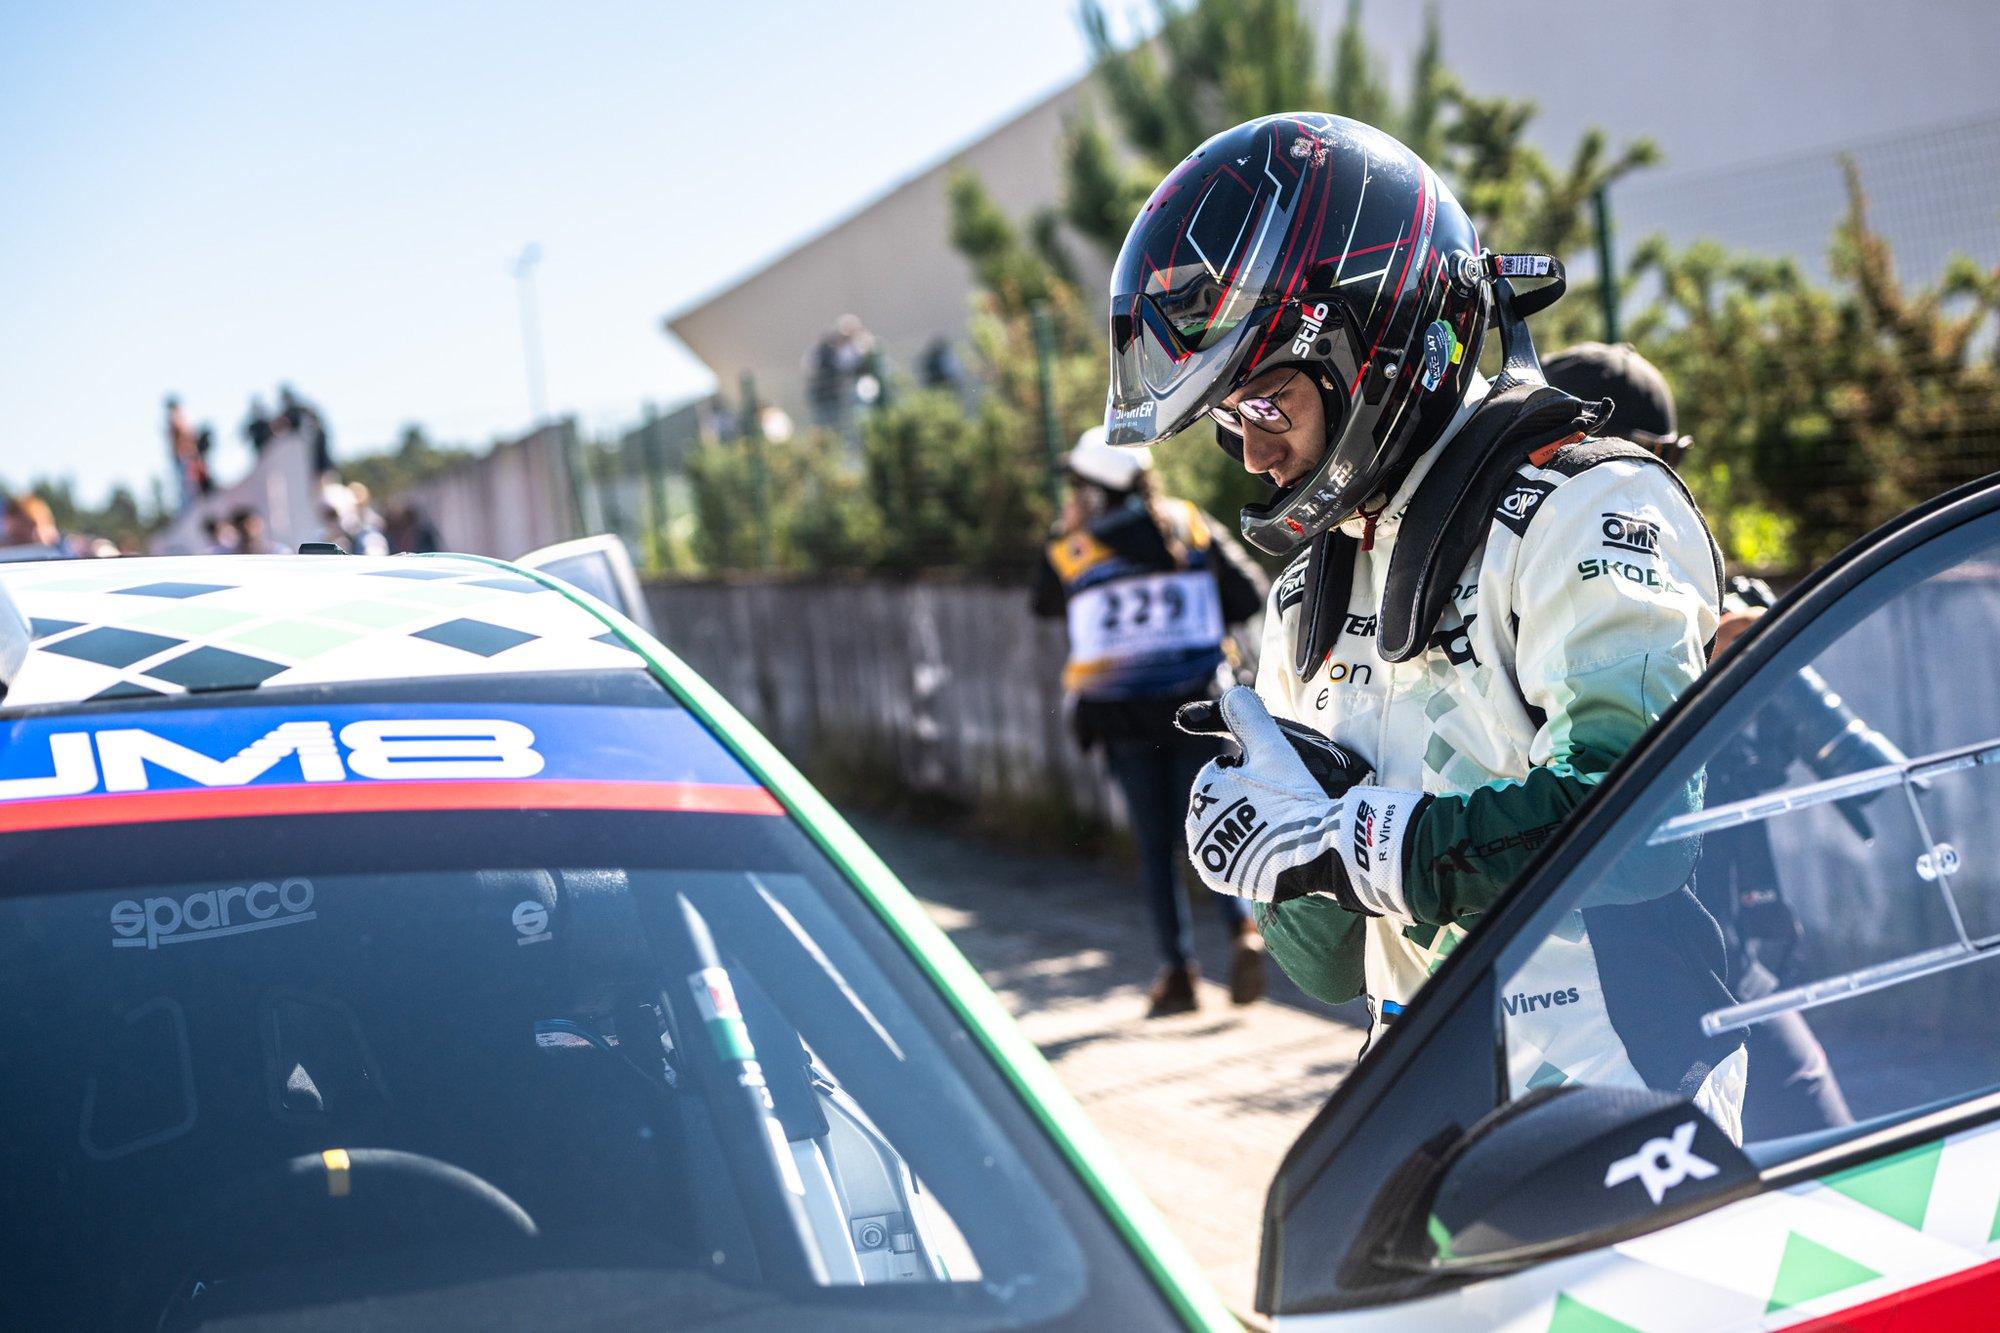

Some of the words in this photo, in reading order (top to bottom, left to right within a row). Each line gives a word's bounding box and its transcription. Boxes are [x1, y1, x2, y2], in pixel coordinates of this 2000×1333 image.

[1291, 303, 1329, 359] stilo
[1201, 804, 1257, 873] OMP
[1379, 804, 1397, 844] Virves
[111, 877, 315, 950] sparco
[1502, 987, 1580, 1017] Virves
